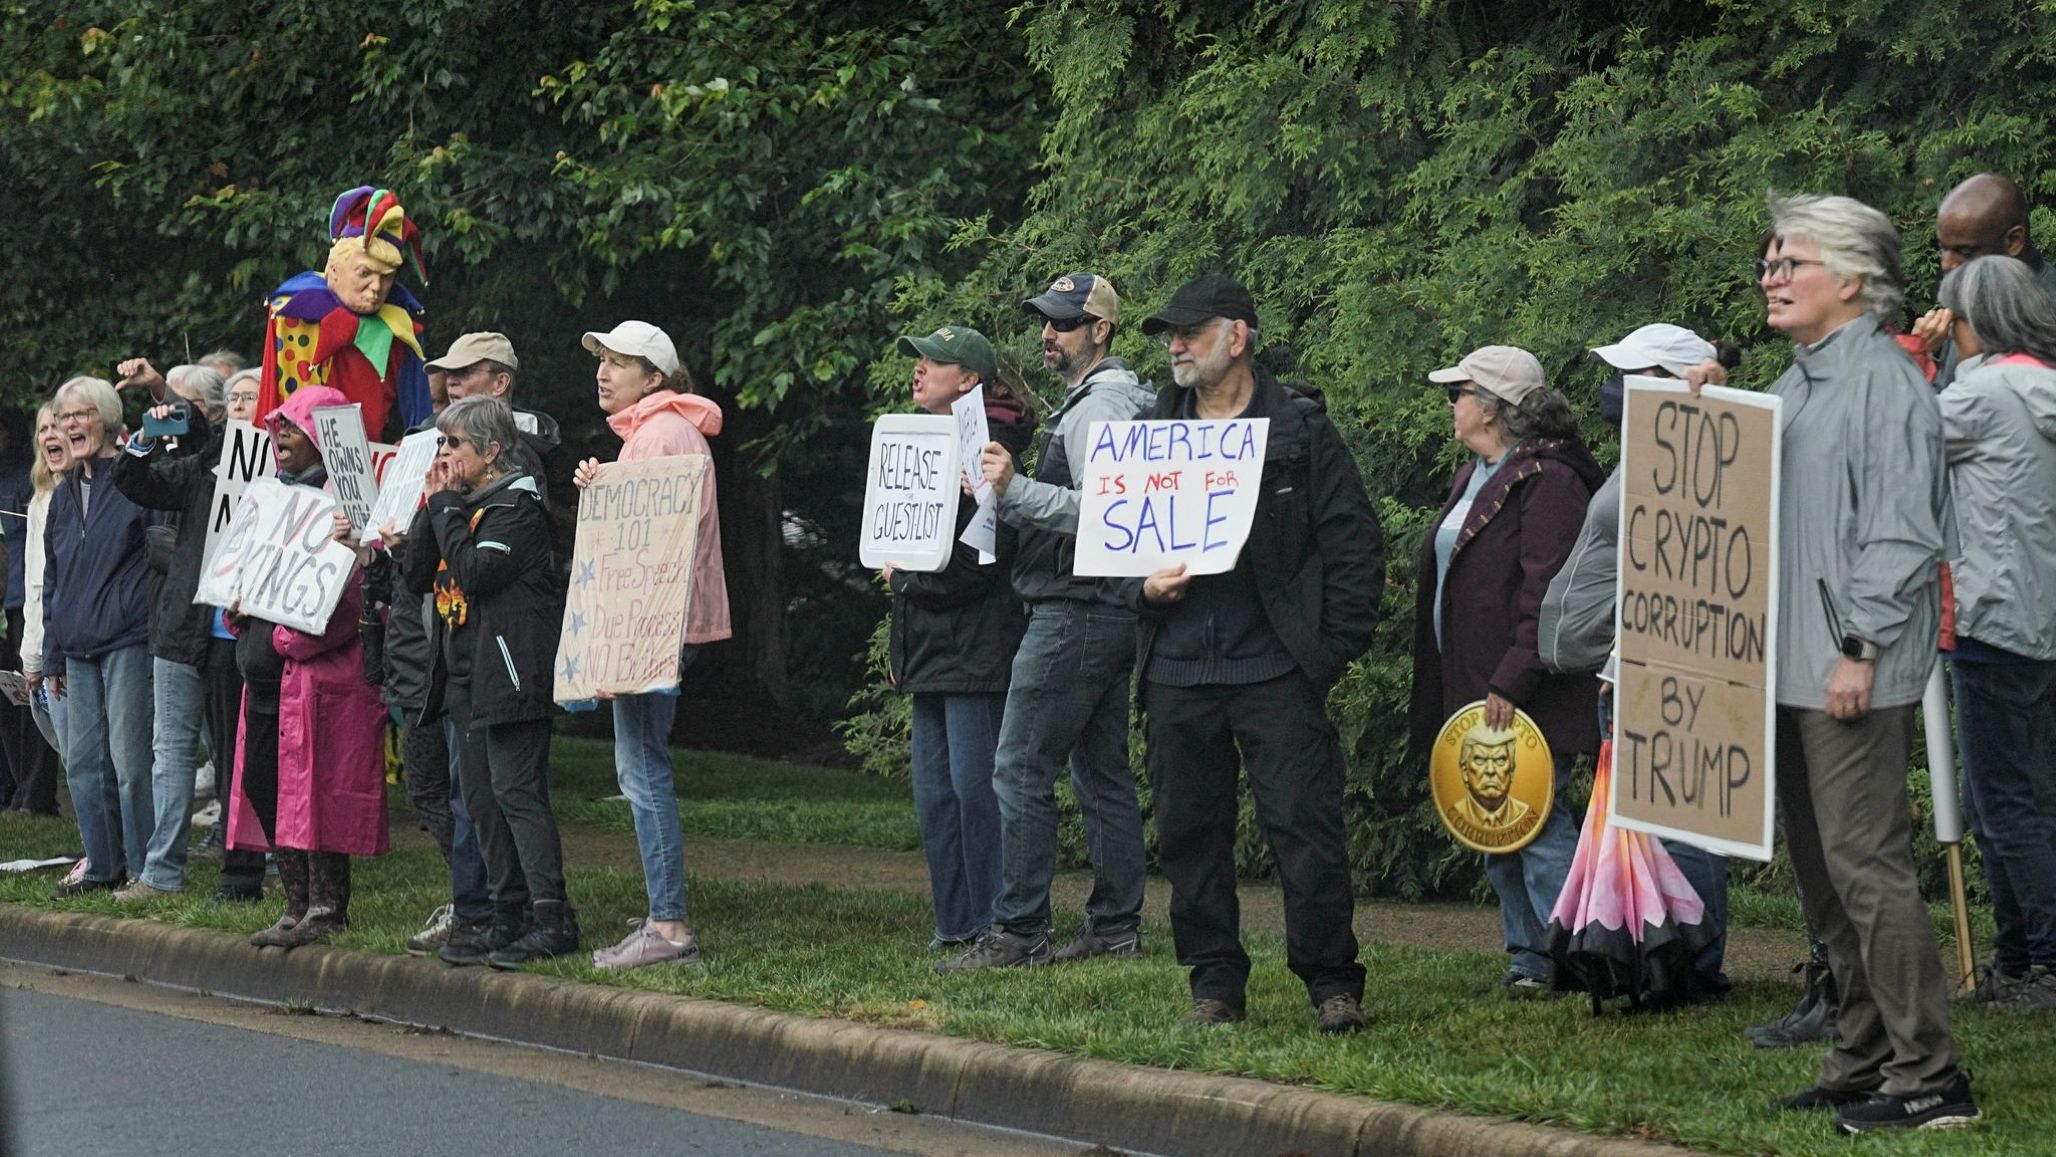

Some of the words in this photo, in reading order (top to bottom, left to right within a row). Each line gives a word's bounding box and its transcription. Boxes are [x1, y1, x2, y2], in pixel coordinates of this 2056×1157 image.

[321, 418, 341, 447] HE
[1090, 423, 1255, 462] AMERICA
[329, 447, 364, 474] OWNS
[879, 443, 941, 491] RELEASE
[1653, 400, 1740, 509] STOP
[335, 475, 361, 500] YOU
[580, 471, 703, 522] DEMOCRACY
[1098, 474, 1126, 495] IS
[1144, 471, 1182, 492] NOT
[267, 492, 335, 554] NO
[614, 519, 651, 550] 101
[1104, 490, 1235, 553] SALE
[598, 553, 632, 592] Free
[1629, 505, 1752, 600] CRYPTO
[236, 540, 336, 617] KINGS
[592, 605, 622, 640] Due
[626, 600, 680, 640] Process
[1622, 589, 1766, 664] CORRUPTION
[581, 645, 609, 684] NO
[1661, 677, 1705, 733] BY
[1446, 712, 1480, 746] STOP
[1625, 729, 1750, 818] TRUMP
[1446, 807, 1539, 846] CORRUPTION
